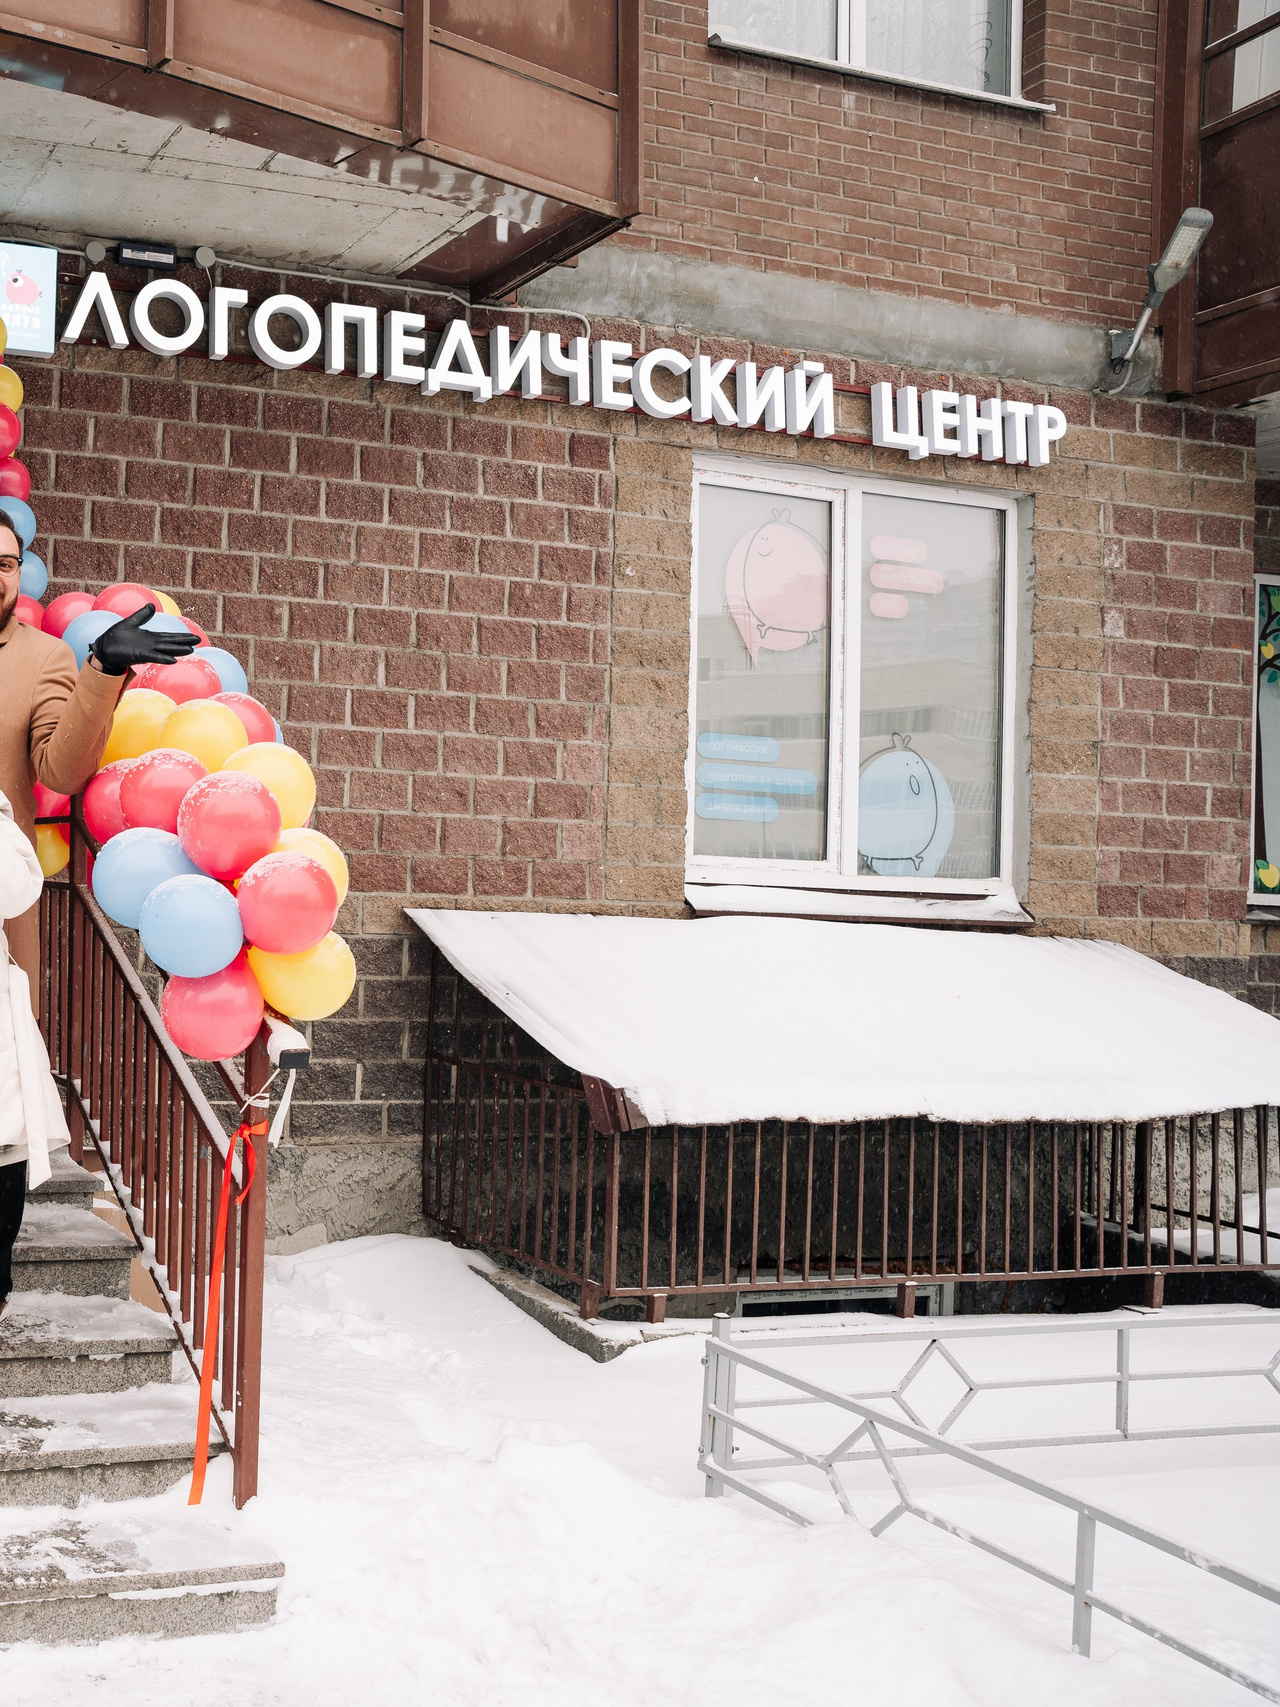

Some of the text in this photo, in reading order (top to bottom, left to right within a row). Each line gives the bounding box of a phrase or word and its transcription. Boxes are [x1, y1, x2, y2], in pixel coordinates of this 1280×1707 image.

[61, 272, 1068, 467] ЛОГОПЕДИЧЕСКИЙ ЦЕНТР
[880, 544, 918, 557] логопед
[880, 572, 934, 586] дефектолог
[708, 742, 769, 754] логомассаж
[708, 772, 765, 784] подготовка
[775, 776, 806, 787] школе
[707, 802, 767, 815] запуск речи
